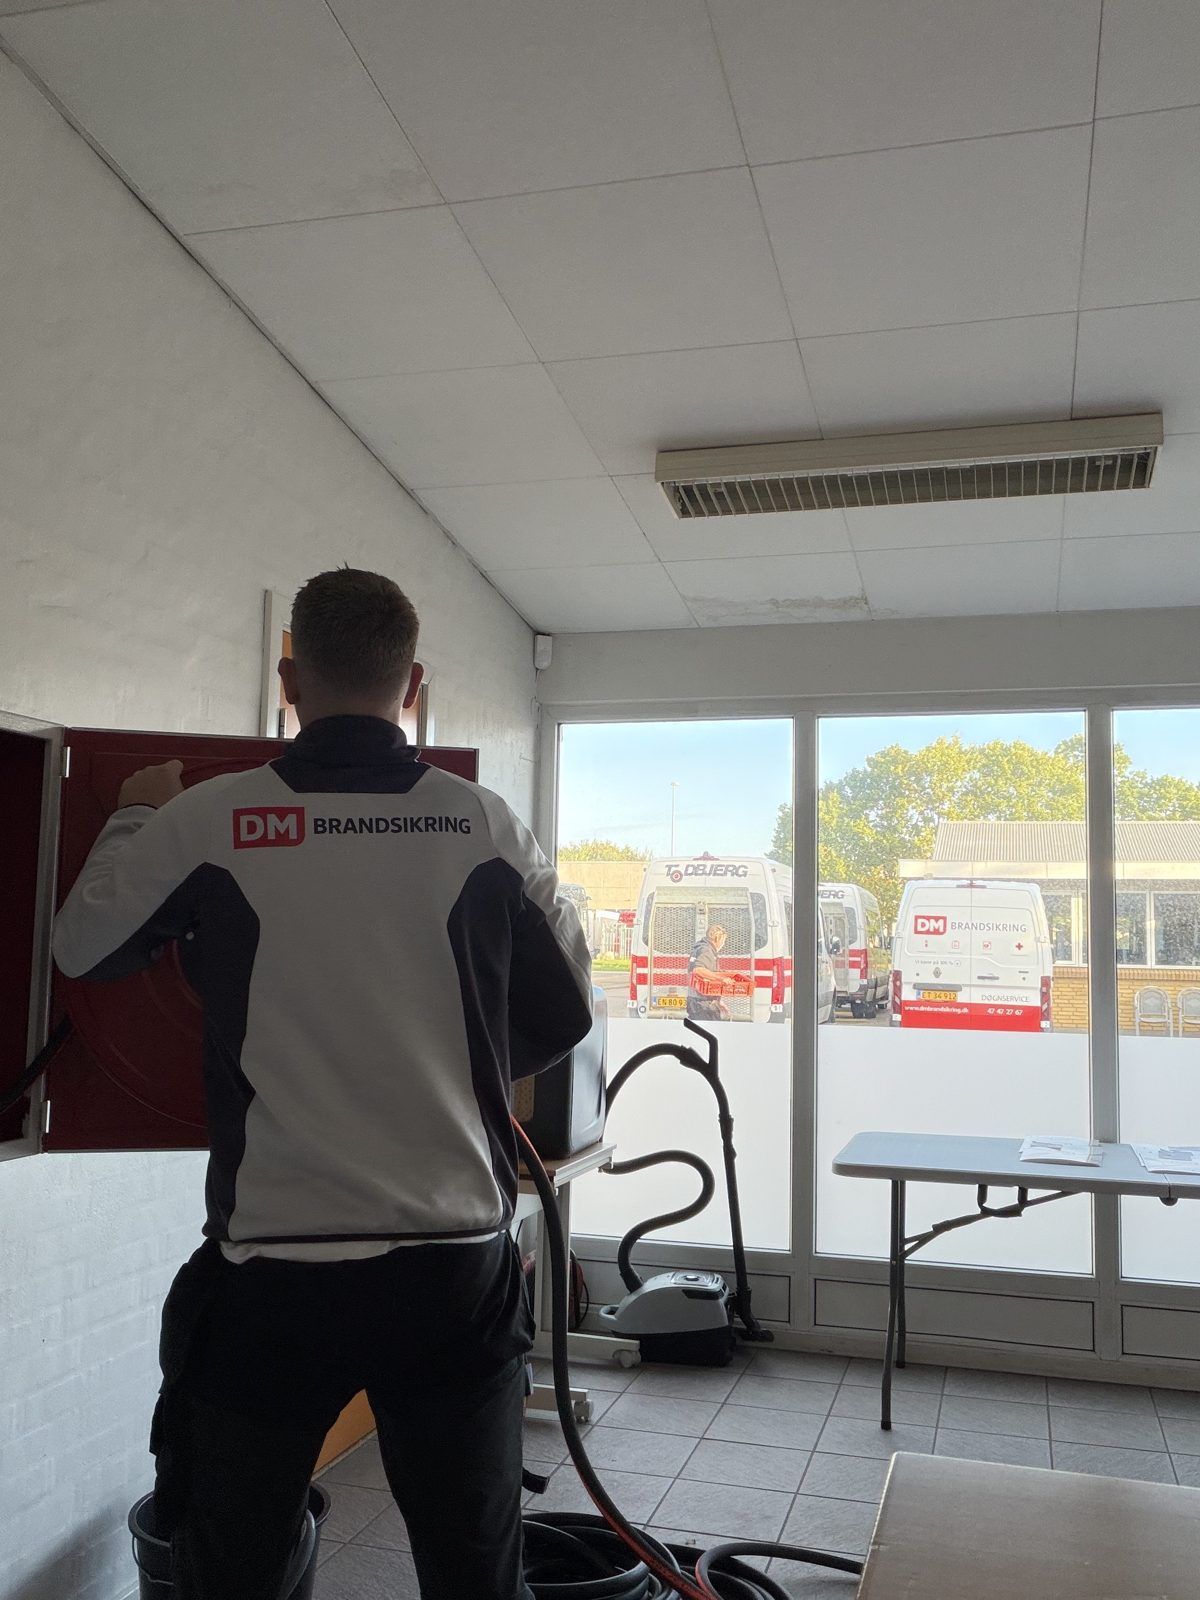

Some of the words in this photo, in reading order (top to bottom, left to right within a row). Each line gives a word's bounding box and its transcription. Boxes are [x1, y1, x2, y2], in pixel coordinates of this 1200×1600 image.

[240, 813, 297, 842] DM
[314, 816, 471, 834] BRANDSIKRING
[818, 889, 845, 899] ERG
[917, 918, 944, 932] DM
[951, 922, 1027, 932] BRANDSIKRING
